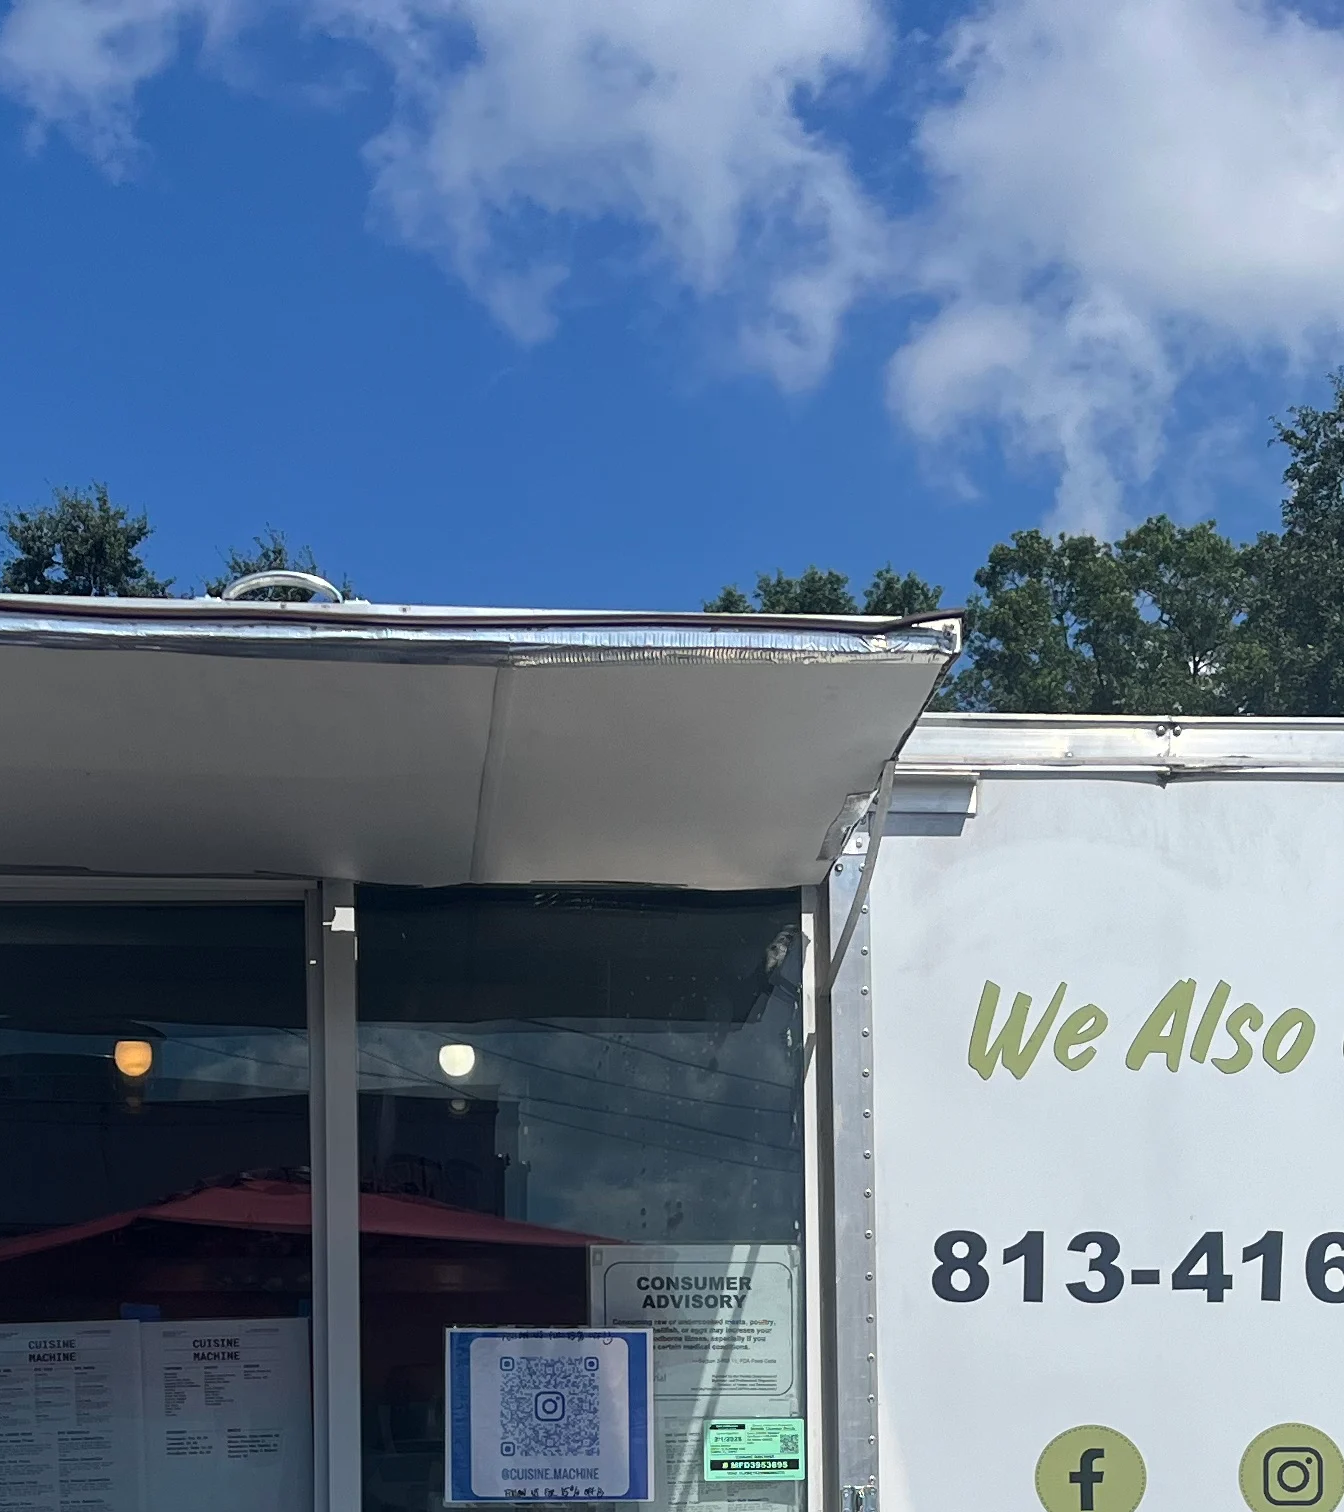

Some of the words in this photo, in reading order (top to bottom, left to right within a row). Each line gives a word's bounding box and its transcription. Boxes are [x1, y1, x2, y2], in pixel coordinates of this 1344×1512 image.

[967, 979, 1109, 1080] We
[1125, 977, 1316, 1075] Also
[636, 1275, 752, 1291] CONSUMER
[641, 1294, 747, 1309] ADVISORY
[28, 1339, 76, 1350] CUISINE
[192, 1338, 240, 1348] CUISINE
[28, 1352, 77, 1362] MACHINE
[193, 1351, 241, 1361] MACHINE
[501, 1467, 599, 1481] @CUISINE.MACHINE
